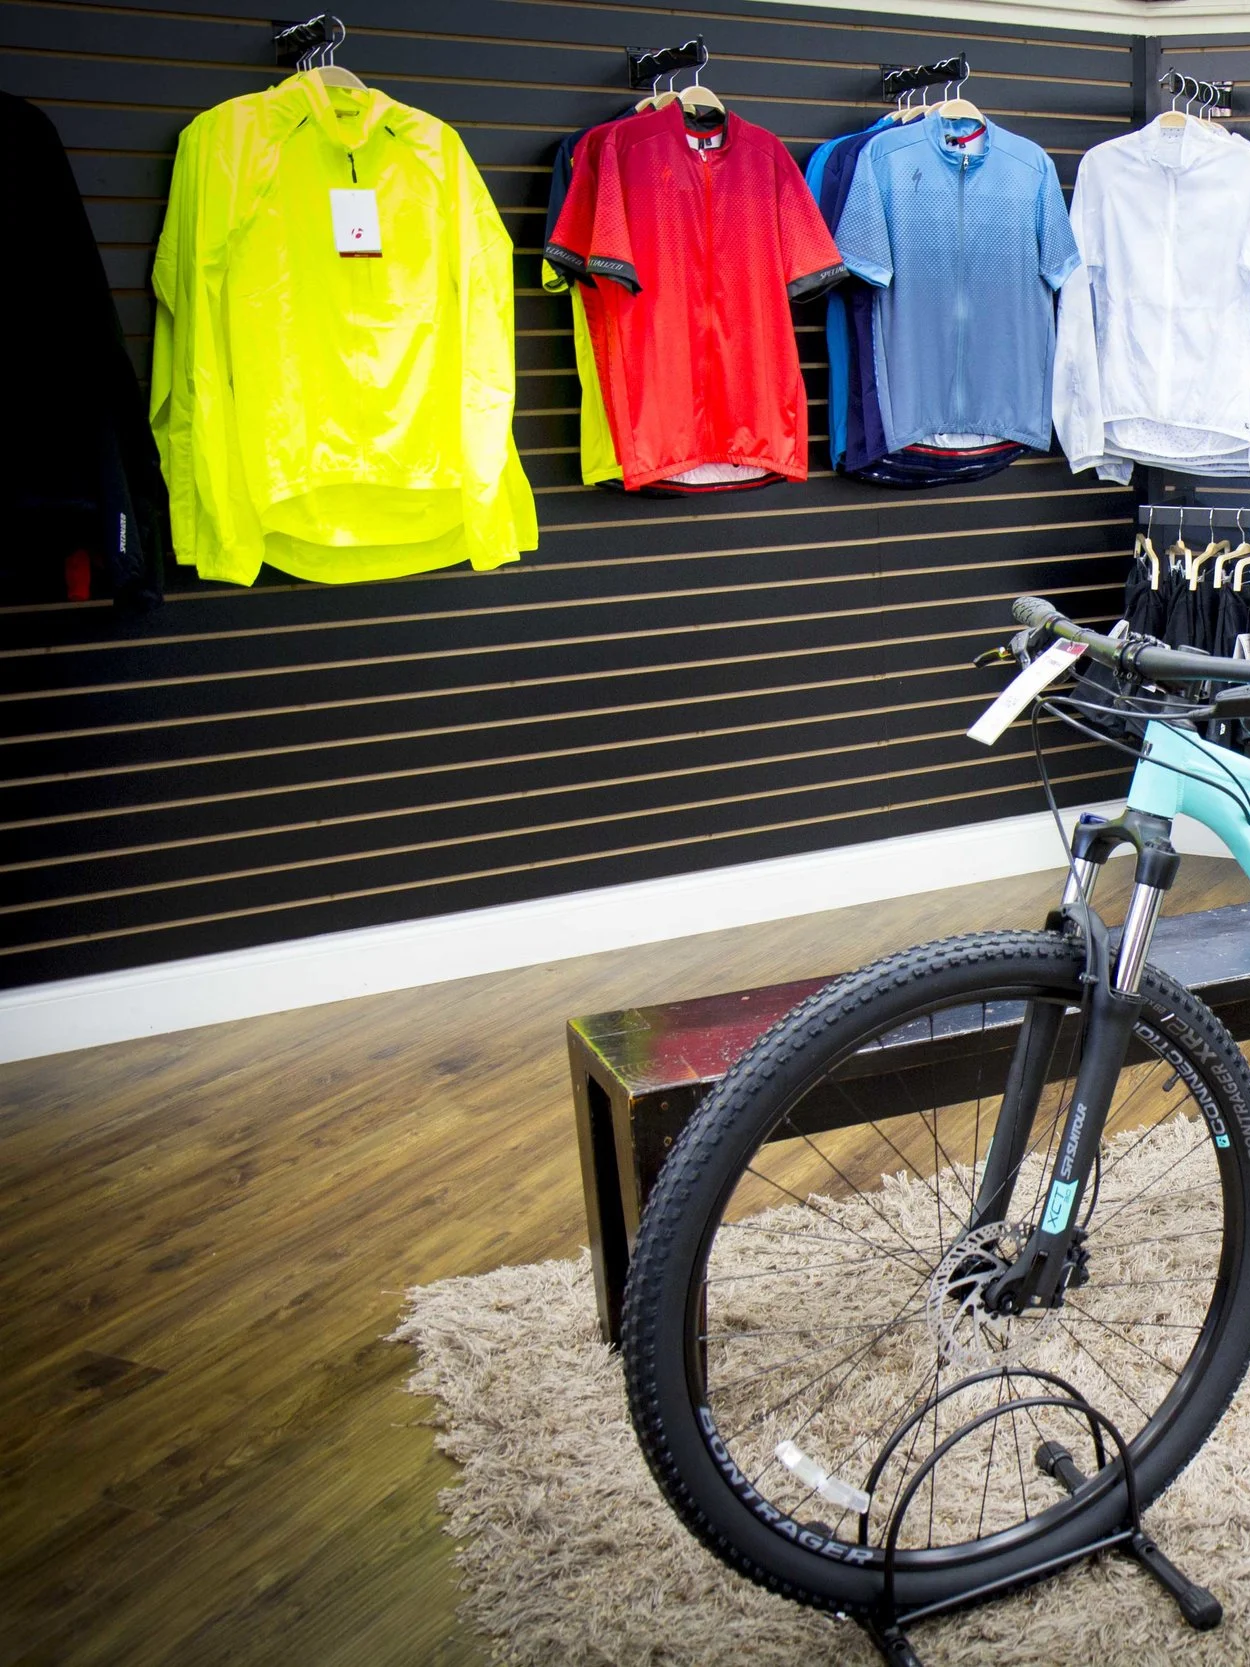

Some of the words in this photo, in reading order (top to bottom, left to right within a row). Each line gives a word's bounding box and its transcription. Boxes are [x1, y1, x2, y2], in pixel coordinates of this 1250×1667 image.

[1167, 1016, 1217, 1065] XR2
[1066, 1103, 1087, 1157] SUNTOUR
[1060, 1157, 1074, 1180] SR
[1047, 1187, 1064, 1228] XCT
[699, 1408, 875, 1565] BONTRAGER
